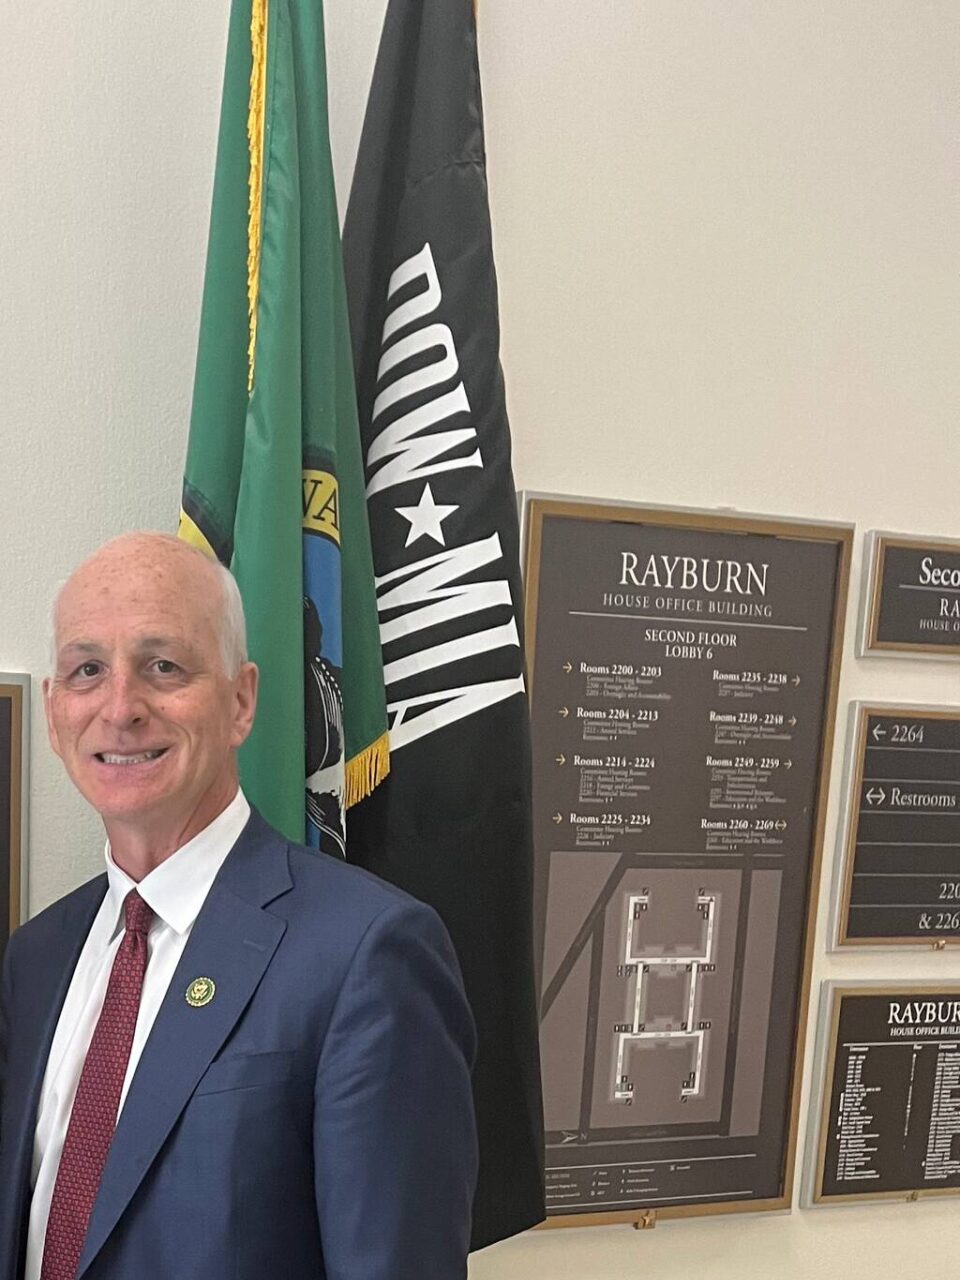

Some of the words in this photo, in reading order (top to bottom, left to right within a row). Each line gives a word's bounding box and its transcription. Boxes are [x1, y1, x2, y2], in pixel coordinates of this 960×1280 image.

[618, 551, 769, 596] RAYBURN
[919, 556, 960, 587] Seco
[603, 592, 650, 609] HOUSE
[655, 597, 702, 612] OFFICE
[709, 601, 772, 617] BUILDING
[939, 598, 960, 618] RA
[920, 618, 950, 632] HOUSE
[374, 530, 526, 752] MIA
[644, 628, 695, 644] SECOND
[698, 631, 737, 647] FLOOR
[665, 644, 704, 659] LOBBY
[706, 647, 713, 660] 6
[580, 662, 609, 674] Rooms
[611, 664, 633, 675] 2200
[641, 666, 662, 678] 2203
[713, 669, 740, 681] Rooms
[576, 706, 606, 718] Rooms
[608, 708, 630, 720] 2204
[637, 709, 659, 721] 2213
[709, 710, 736, 722] Rooms
[891, 724, 924, 743] 2264
[573, 754, 603, 766] Rooms
[605, 756, 627, 767] 2214
[634, 757, 655, 768] 2224
[706, 754, 733, 767] Rooms
[891, 787, 956, 807] Restrooms
[570, 813, 599, 824] Rooms
[601, 813, 623, 825] 2225
[701, 818, 728, 829] Rooms
[918, 912, 932, 930] &
[890, 1026, 914, 1037] HOUSE
[915, 1025, 940, 1036] OFFICE
